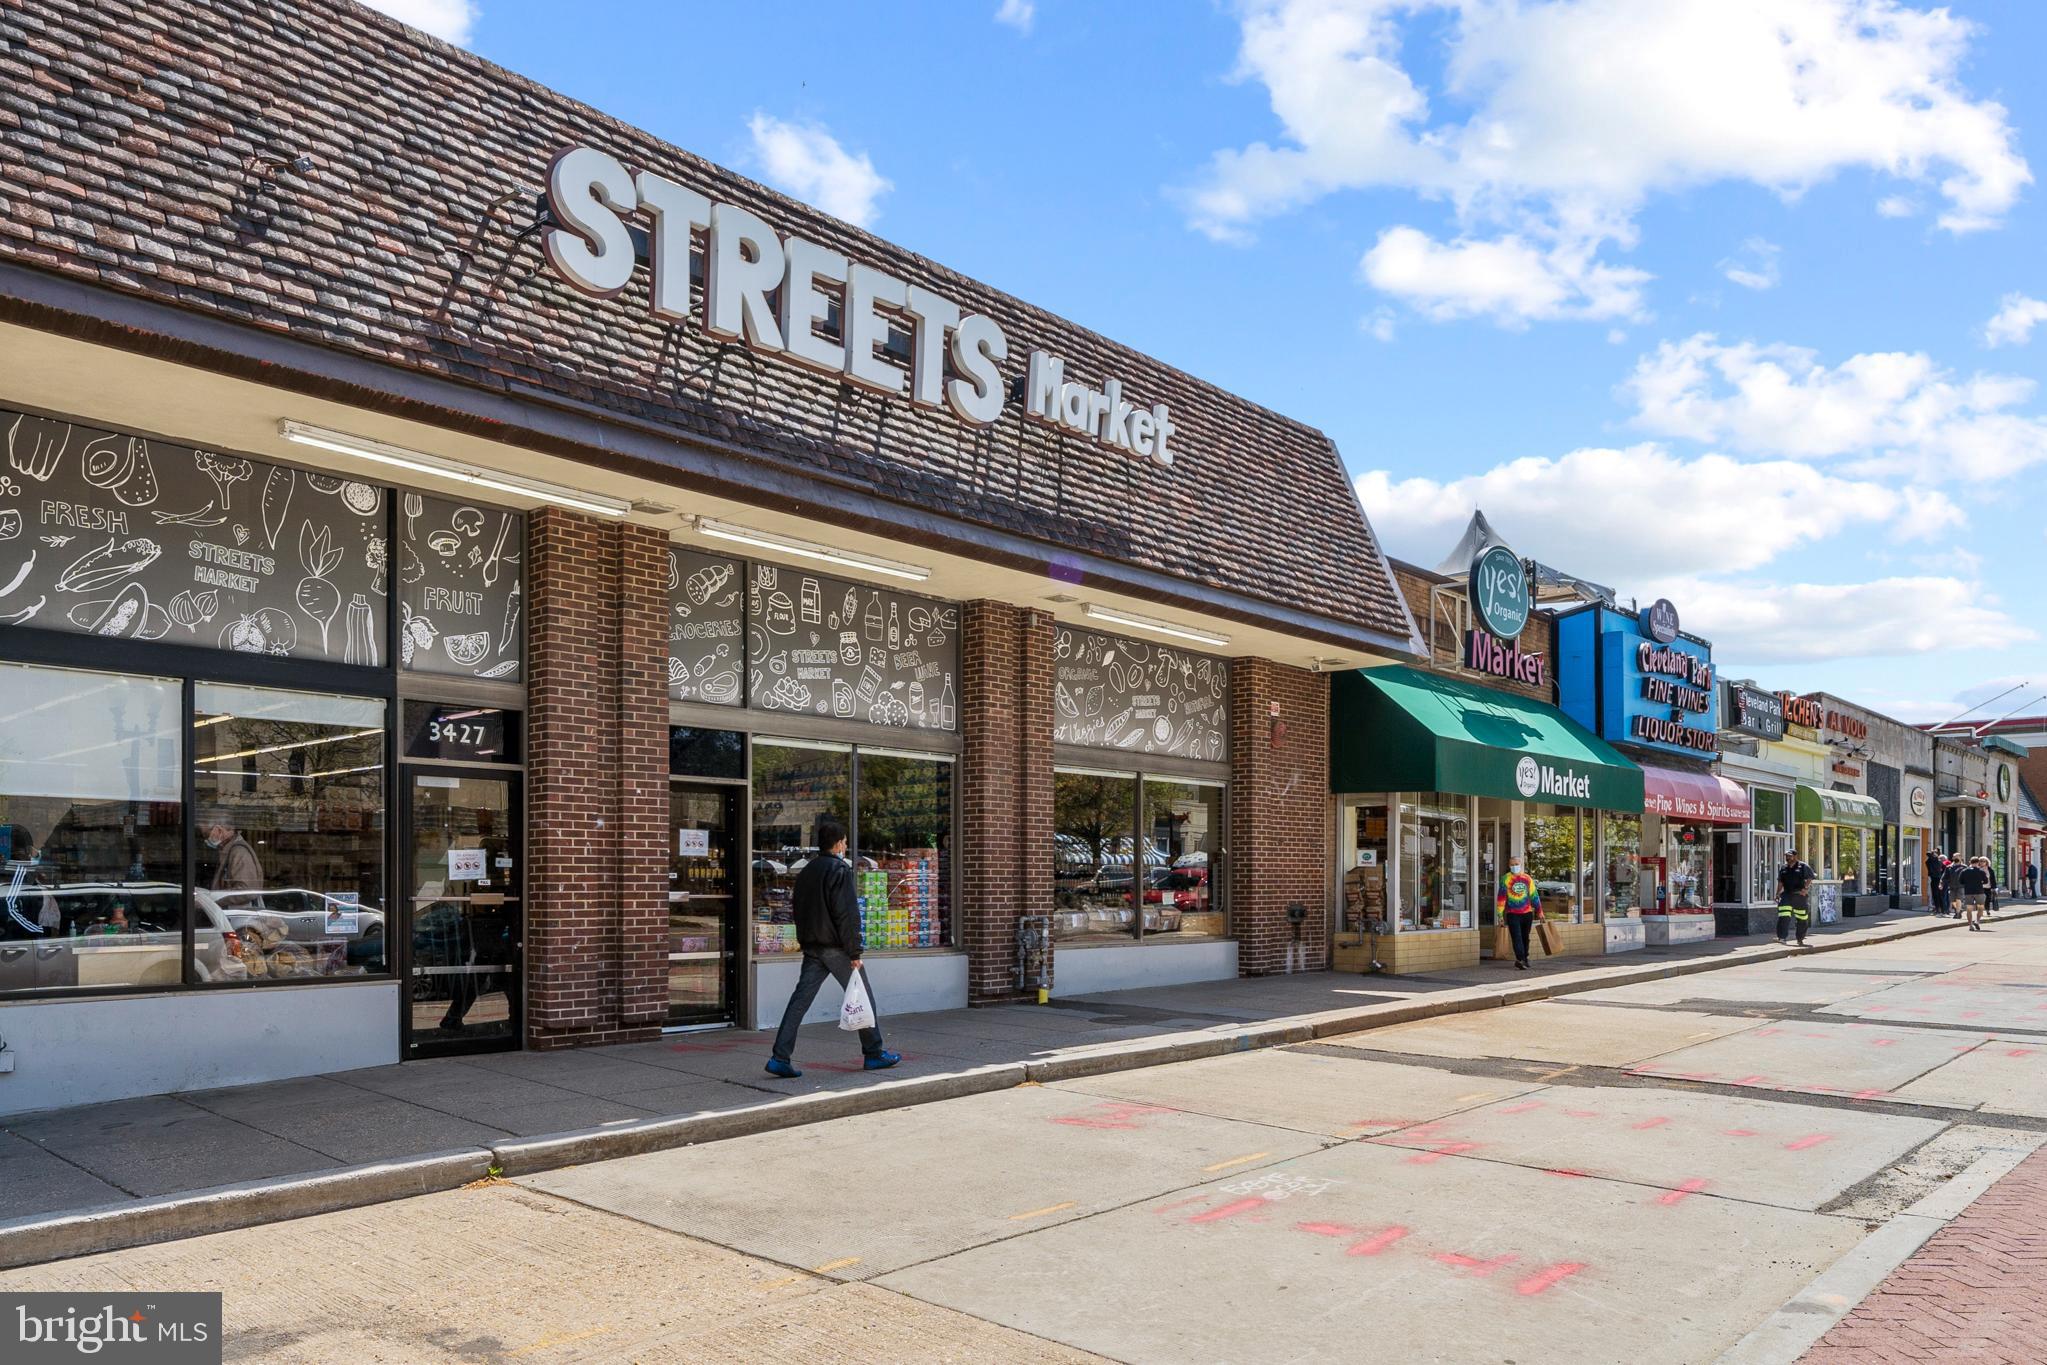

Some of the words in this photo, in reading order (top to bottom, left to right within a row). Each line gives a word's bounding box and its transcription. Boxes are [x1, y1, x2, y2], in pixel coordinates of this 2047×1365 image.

[543, 145, 1008, 428] STREETS
[1027, 350, 1175, 467] Market
[40, 499, 129, 534] FRESH
[188, 539, 276, 576] STREETS
[194, 565, 259, 594] MARKET
[773, 612, 789, 621] FLOUR
[1494, 602, 1522, 622] Organic
[1656, 606, 1675, 626] WINE
[791, 649, 838, 664] STREETS
[893, 650, 922, 671] BEER
[1470, 629, 1544, 687] Market
[1640, 642, 1688, 678] Cleveland
[1690, 655, 1713, 690] Park
[797, 667, 831, 680] MARKET
[1647, 677, 1675, 705] FINE
[1677, 685, 1711, 715] WINES
[1742, 691, 1769, 713] Cleveland
[1769, 700, 1782, 717] Park
[428, 720, 486, 745] 3427
[1638, 715, 1685, 745] LIQUOR
[1685, 728, 1719, 752] STORE
[1742, 711, 1755, 729] Bar
[1765, 718, 1782, 736] Grill
[1843, 716, 1867, 739] VOLO
[1541, 765, 1590, 799] Market
[1656, 794, 1673, 813] Fine
[1675, 796, 1697, 816] Wines
[1707, 801, 1730, 819] Spirits
